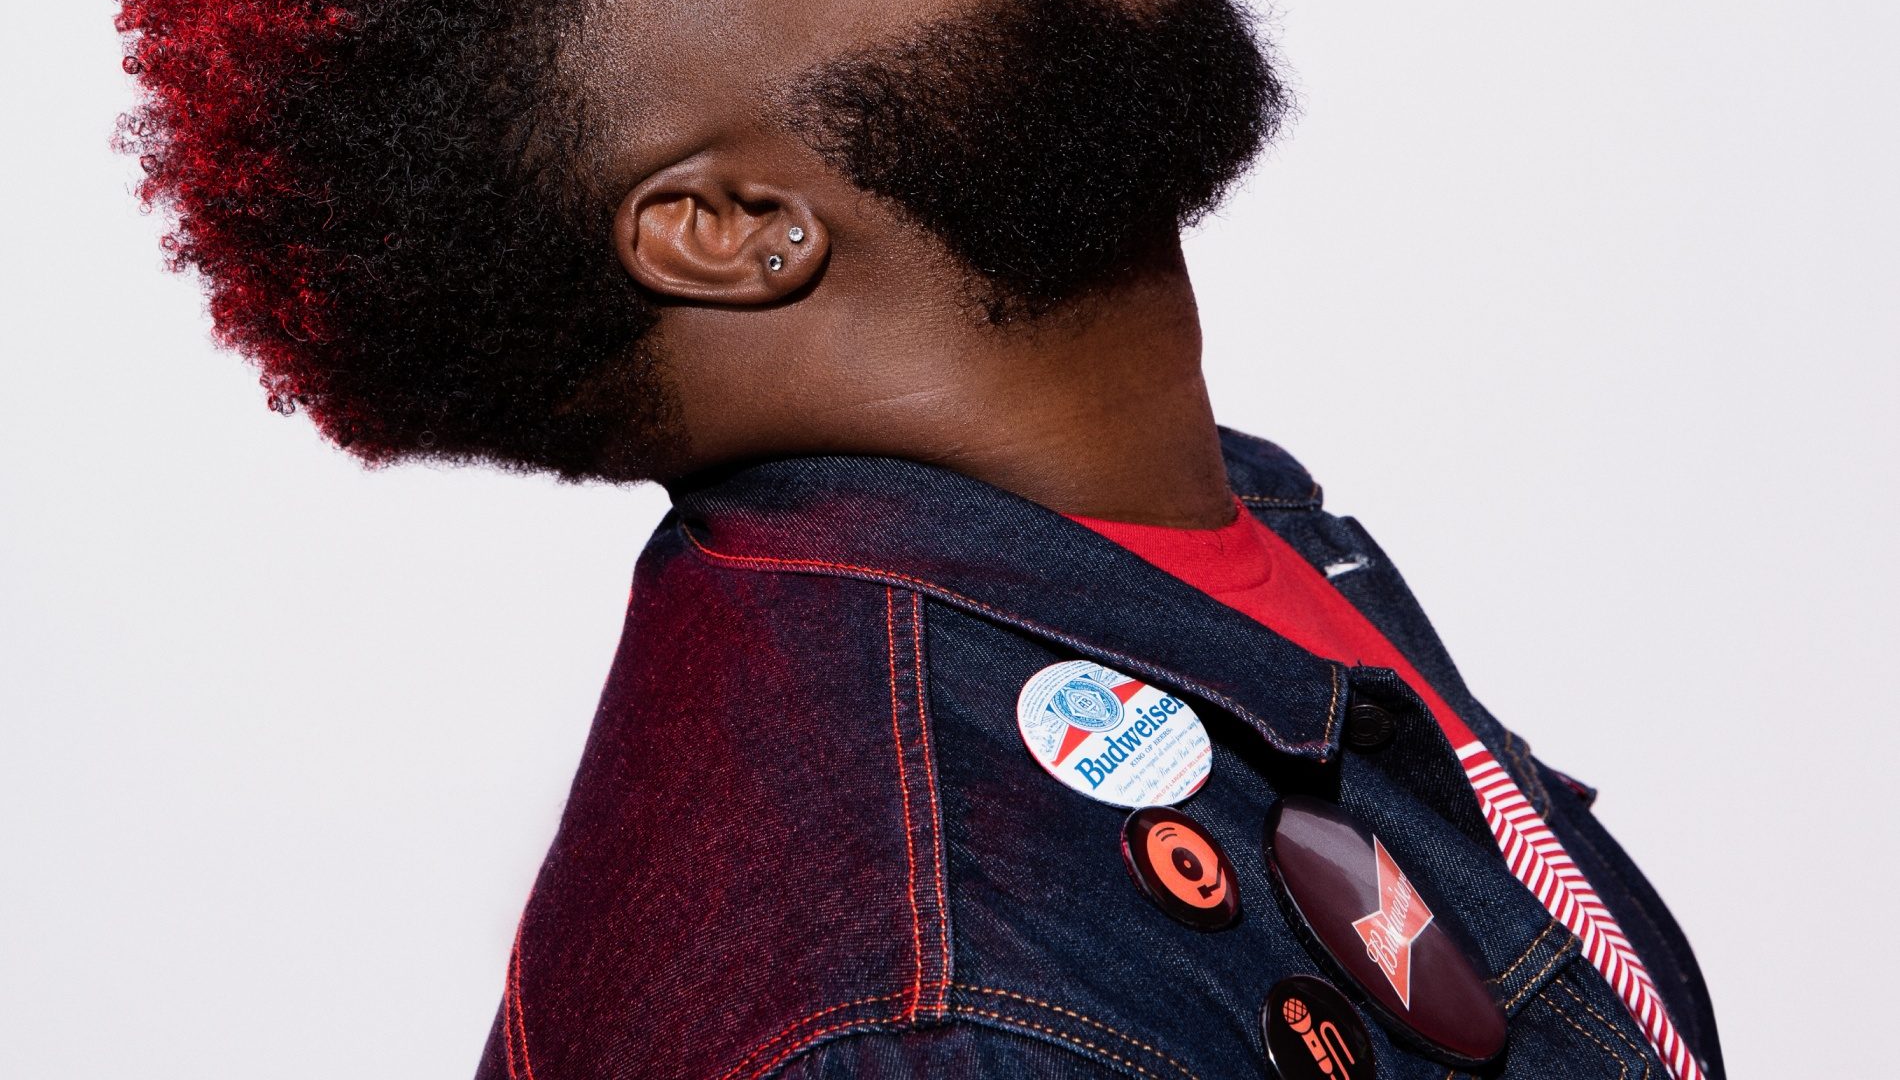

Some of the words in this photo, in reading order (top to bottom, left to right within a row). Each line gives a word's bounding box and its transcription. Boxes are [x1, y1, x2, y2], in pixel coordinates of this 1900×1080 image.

[1074, 693, 1184, 790] Budweiser
[1130, 752, 1146, 768] KING
[1144, 744, 1153, 754] OF
[1366, 873, 1412, 976] Budweiser
